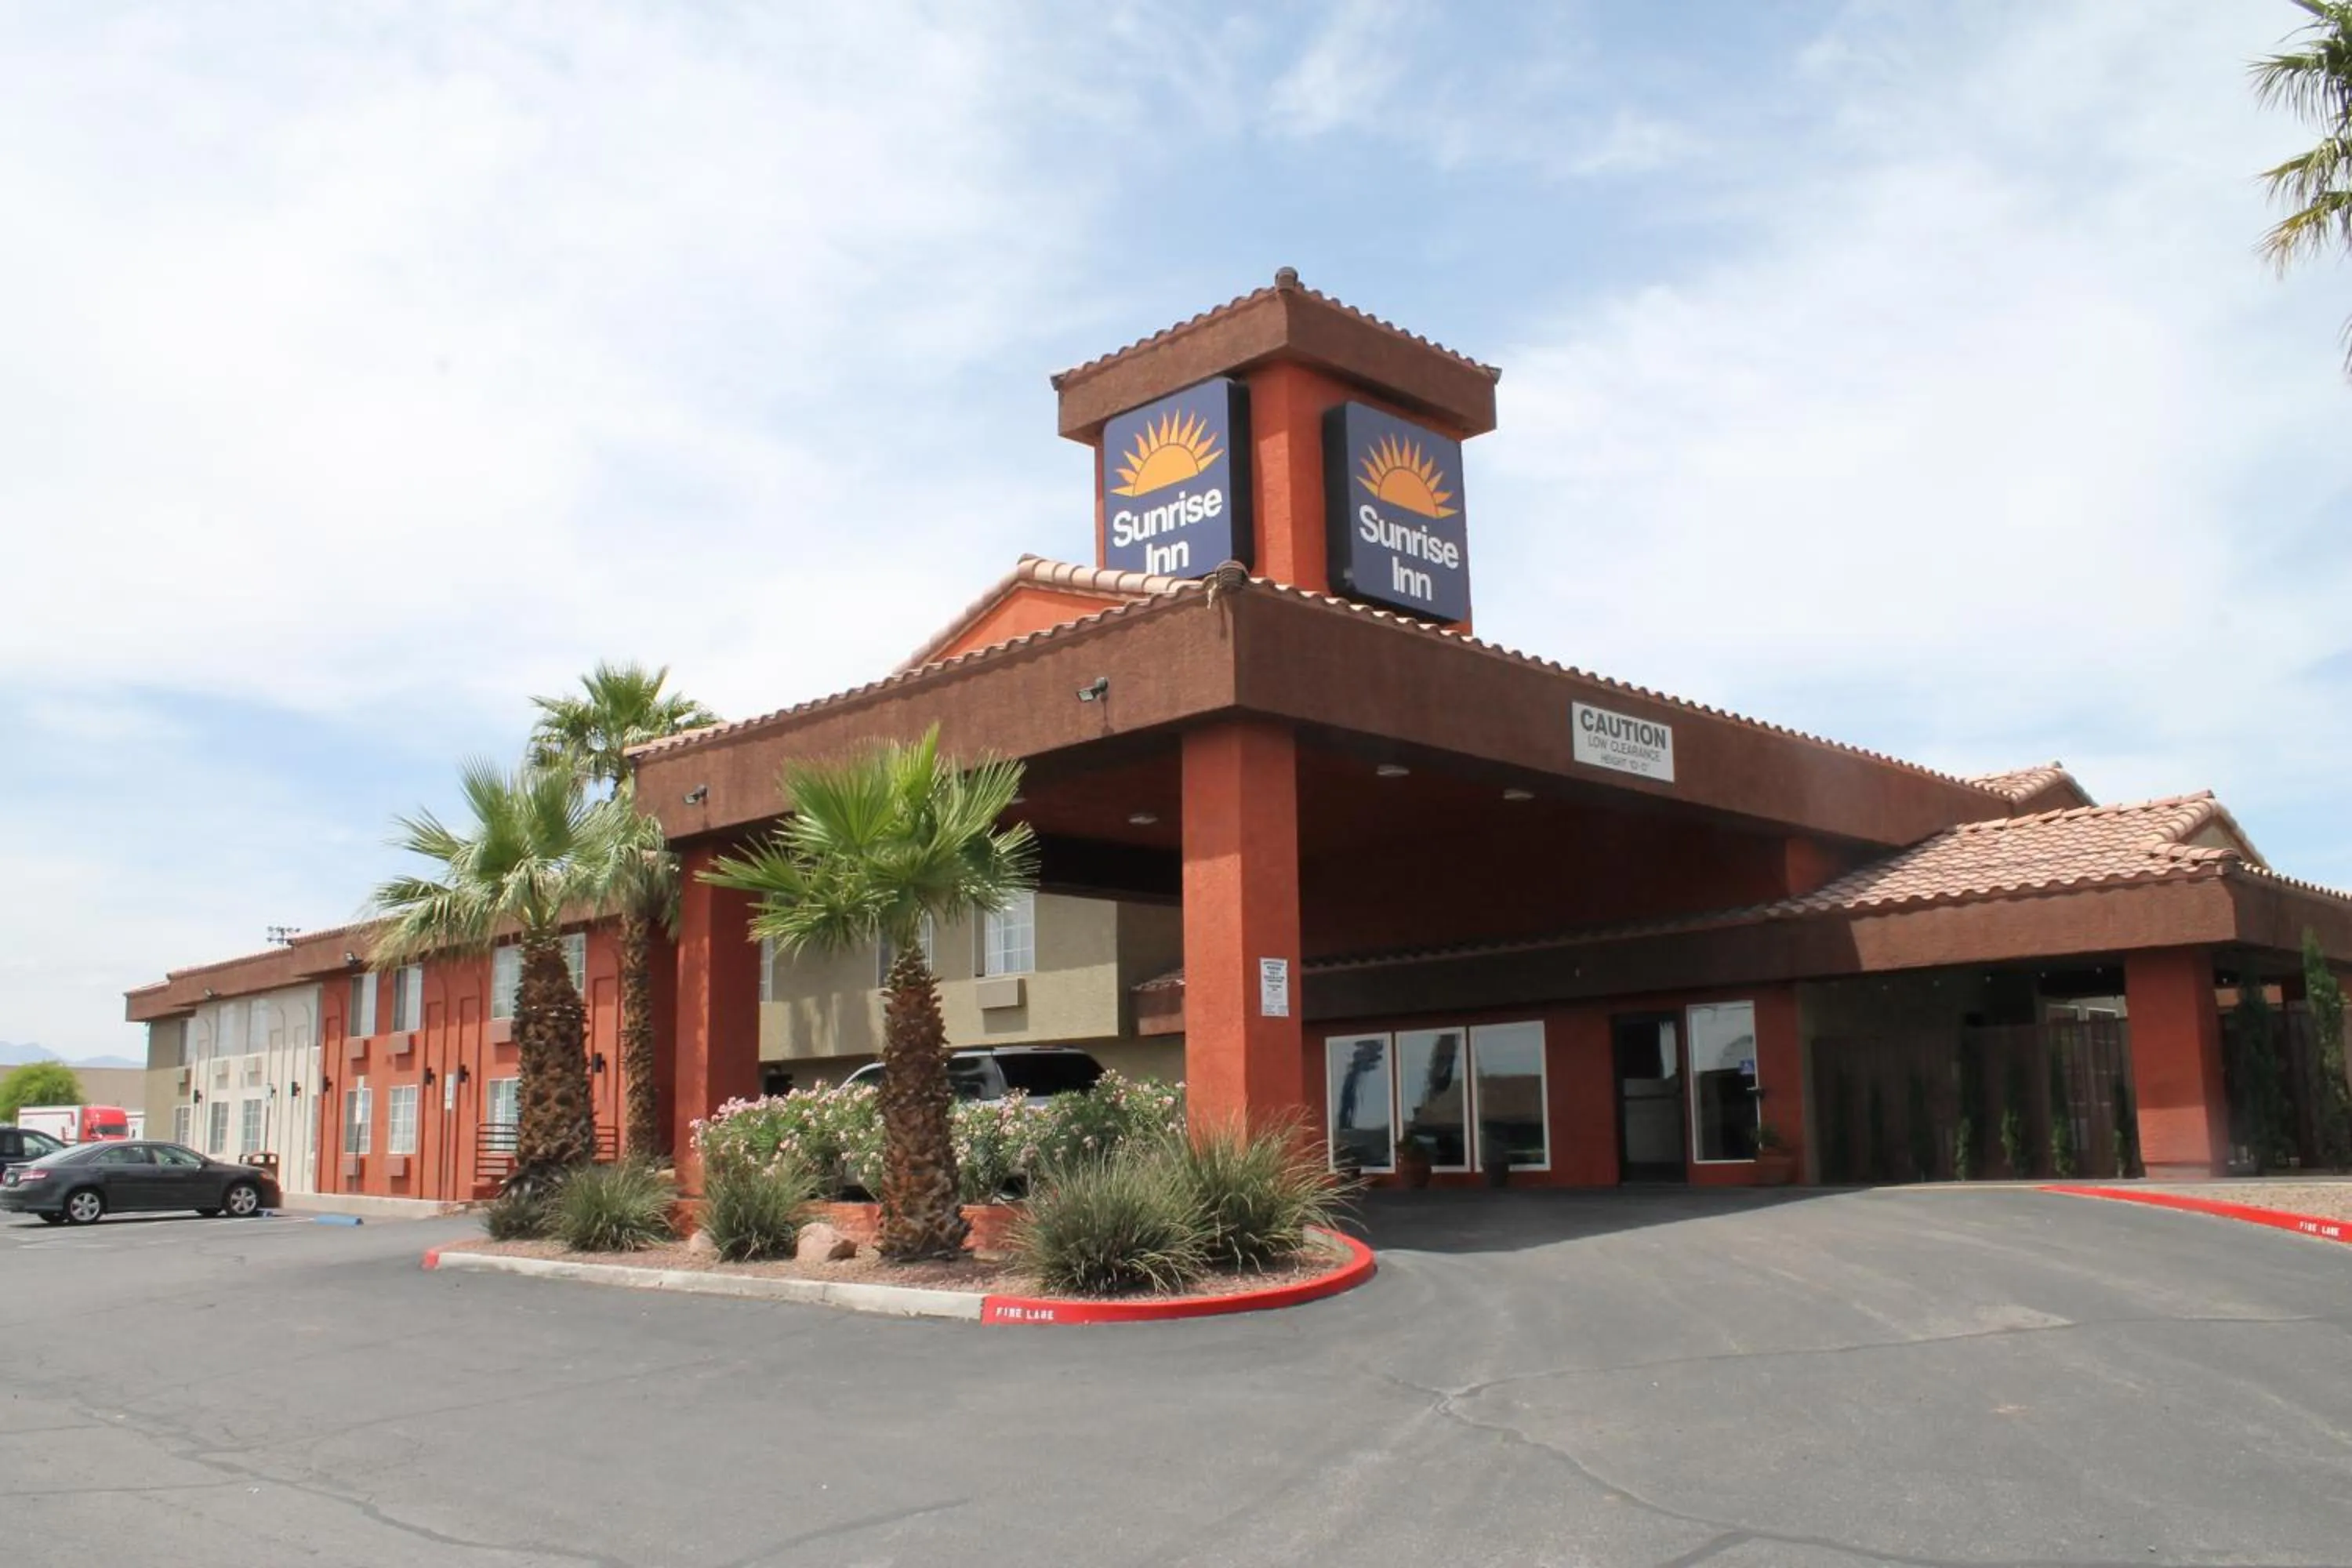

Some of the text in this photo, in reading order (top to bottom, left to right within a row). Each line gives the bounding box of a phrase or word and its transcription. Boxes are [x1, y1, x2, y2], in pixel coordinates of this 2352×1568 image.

[1112, 488, 1222, 547] Sunrise
[1359, 505, 1459, 569] Sunrise
[1145, 539, 1189, 575] Inn
[1392, 557, 1433, 601] Inn
[1581, 709, 1666, 750] CAUTION
[1588, 734, 1661, 763] LOW CLEARANCE
[996, 1307, 1054, 1319] FIRE LANE
